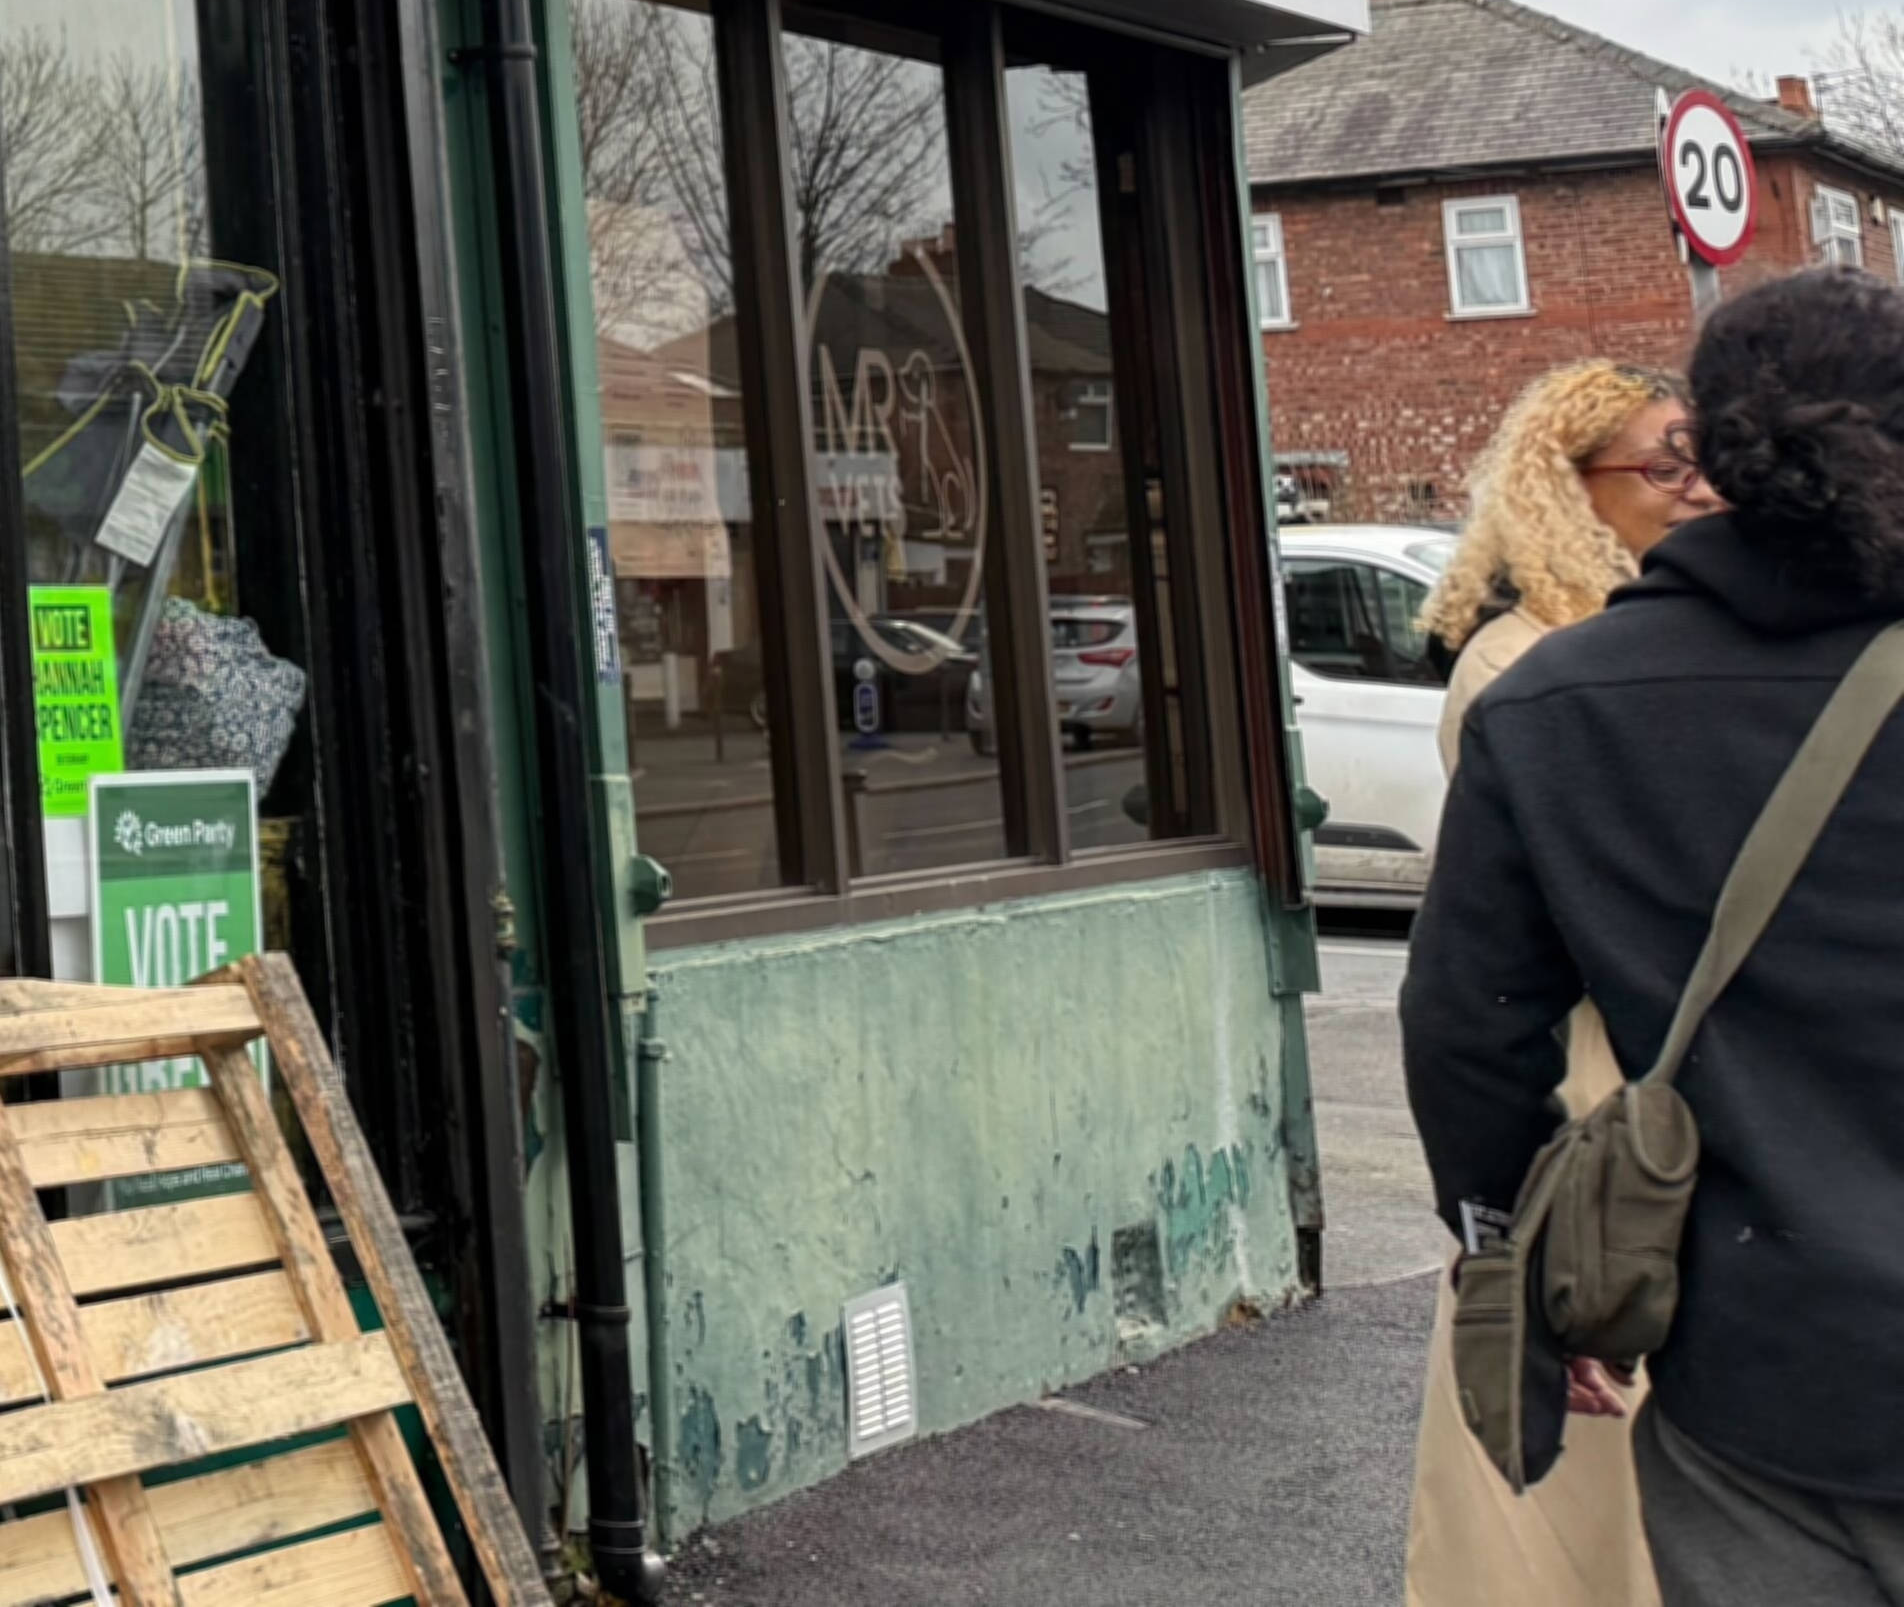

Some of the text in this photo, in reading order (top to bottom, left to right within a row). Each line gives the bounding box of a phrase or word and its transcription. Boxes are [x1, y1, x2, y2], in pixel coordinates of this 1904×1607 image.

[1679, 137, 1744, 214] 20
[818, 343, 898, 459] MR
[35, 608, 90, 650] VOTE
[39, 702, 114, 743] PENCER
[143, 817, 235, 849] Green Party
